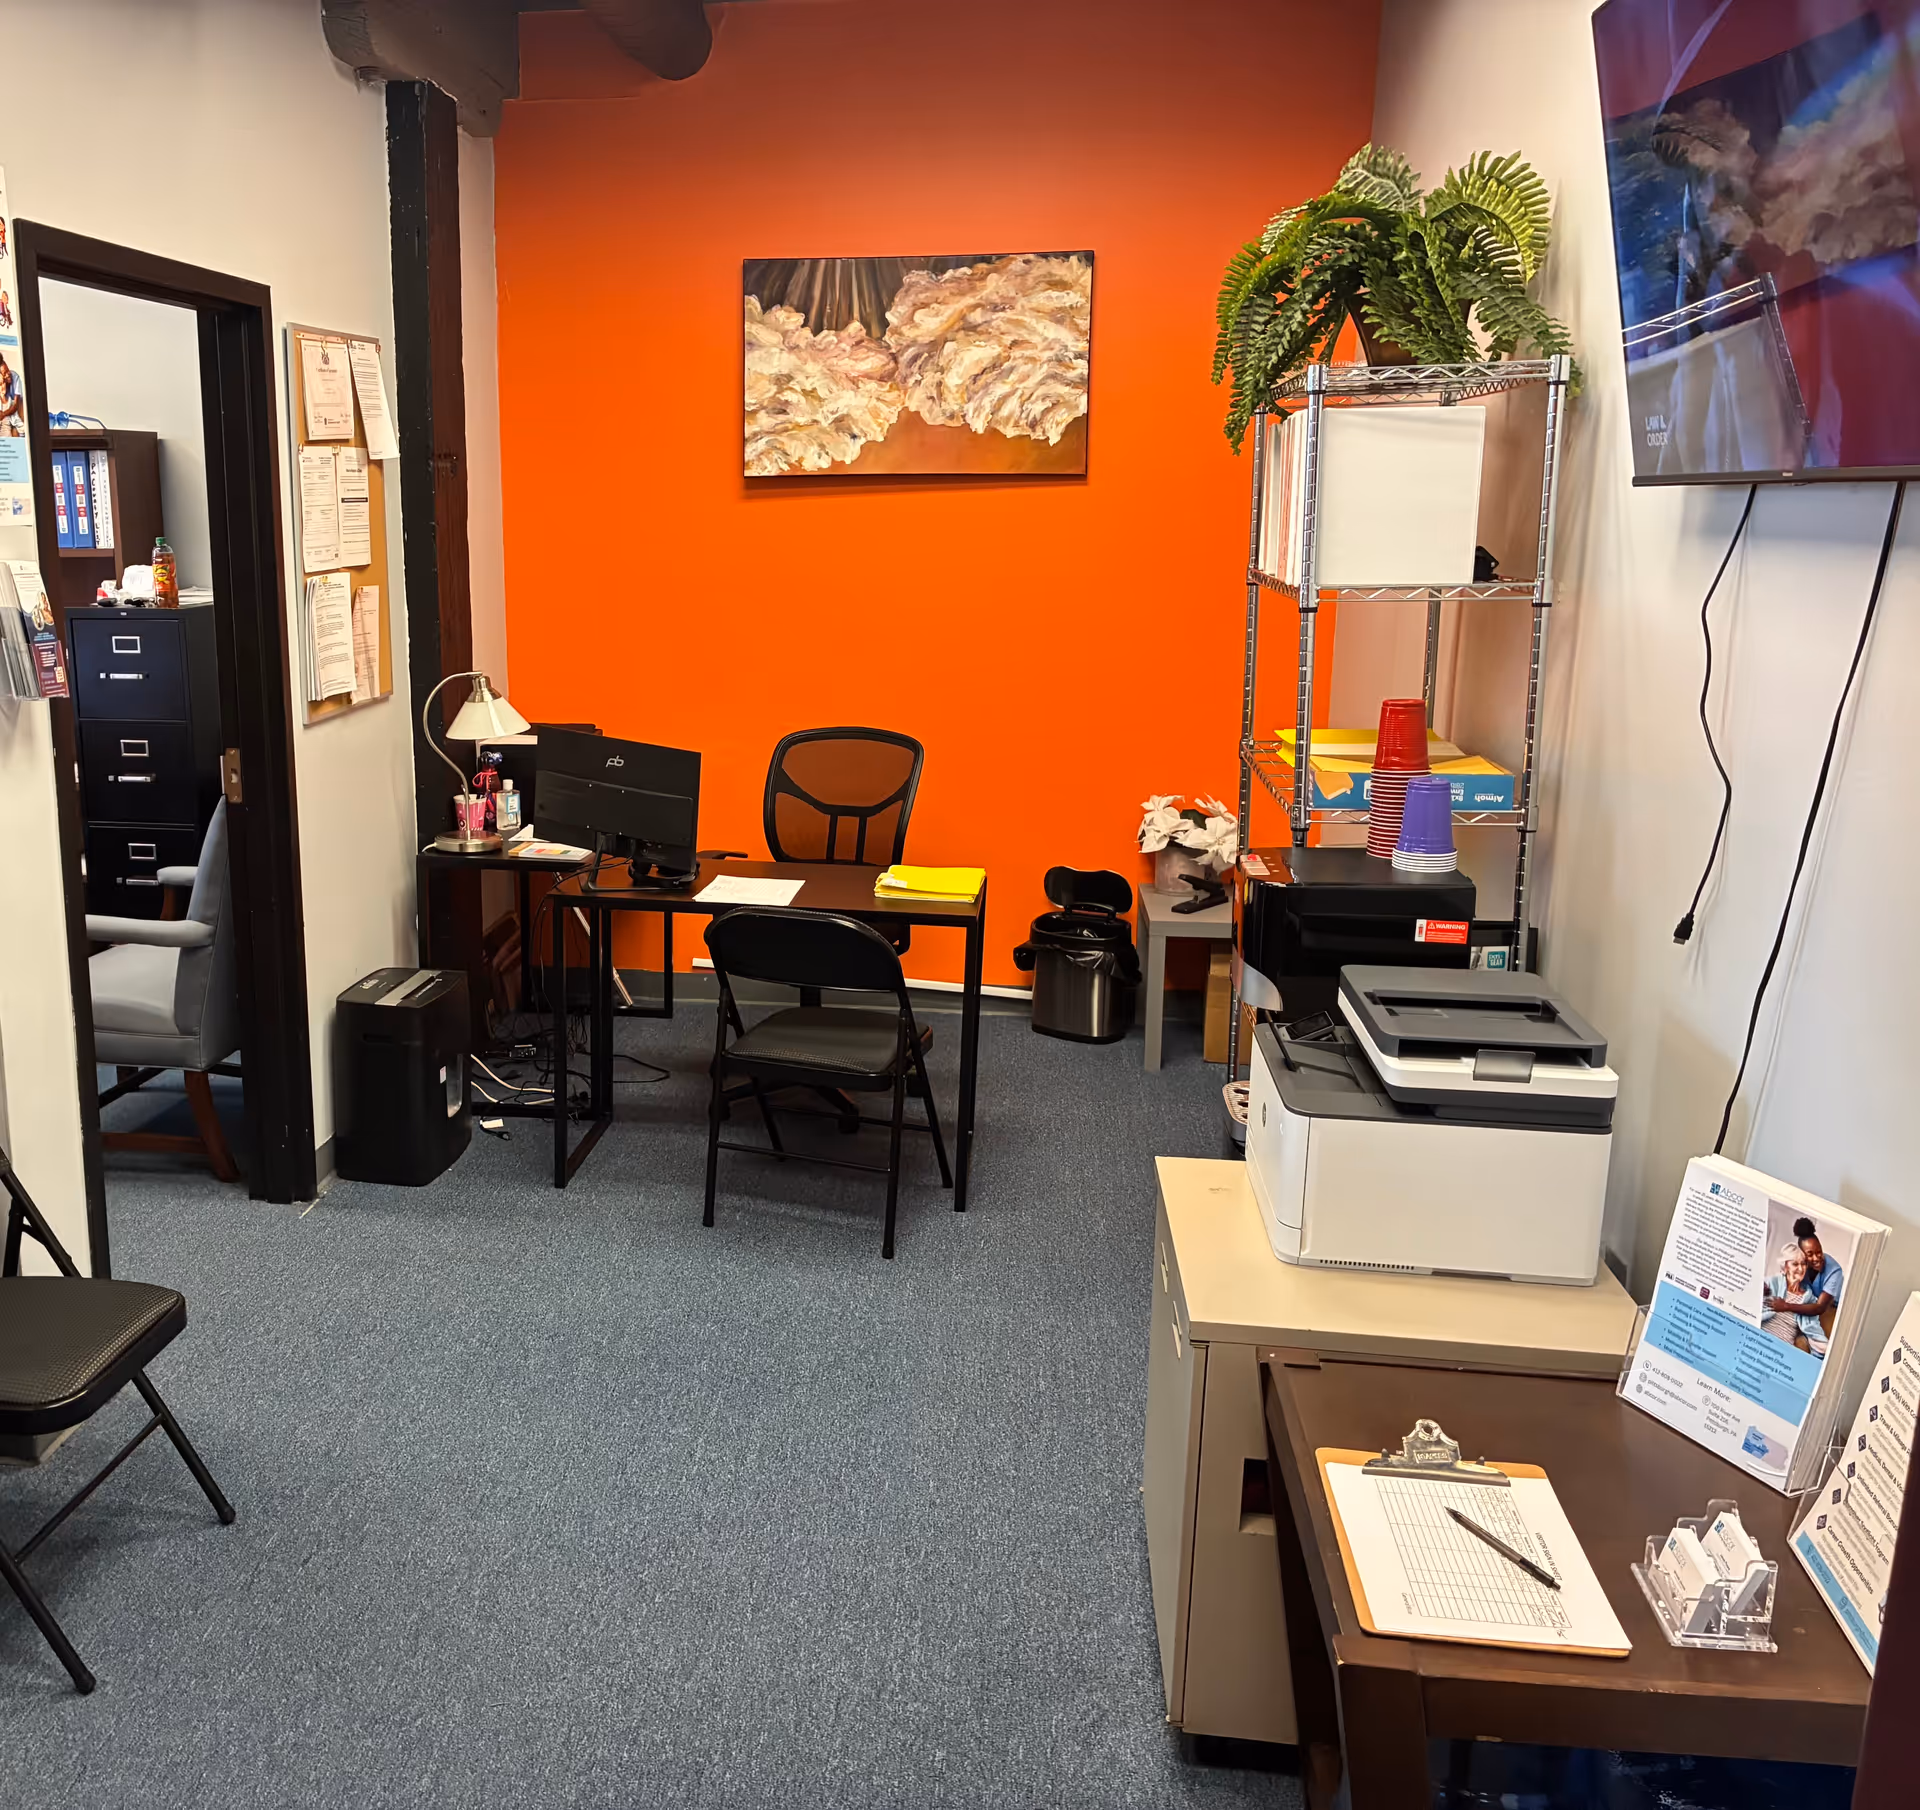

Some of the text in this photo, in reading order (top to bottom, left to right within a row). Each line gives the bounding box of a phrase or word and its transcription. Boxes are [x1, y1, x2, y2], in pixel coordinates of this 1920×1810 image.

[1696, 1377, 1731, 1403] Learn More:
[1880, 1414, 1890, 1431] Travel
[1881, 1462, 1893, 1481] Dental
[1534, 1532, 1548, 1549] VISITOR
[1542, 1549, 1553, 1560] SIGN
[1827, 1525, 1839, 1542] Career
[1837, 1541, 1851, 1561] Growth
[1849, 1558, 1874, 1595] Opportunities
